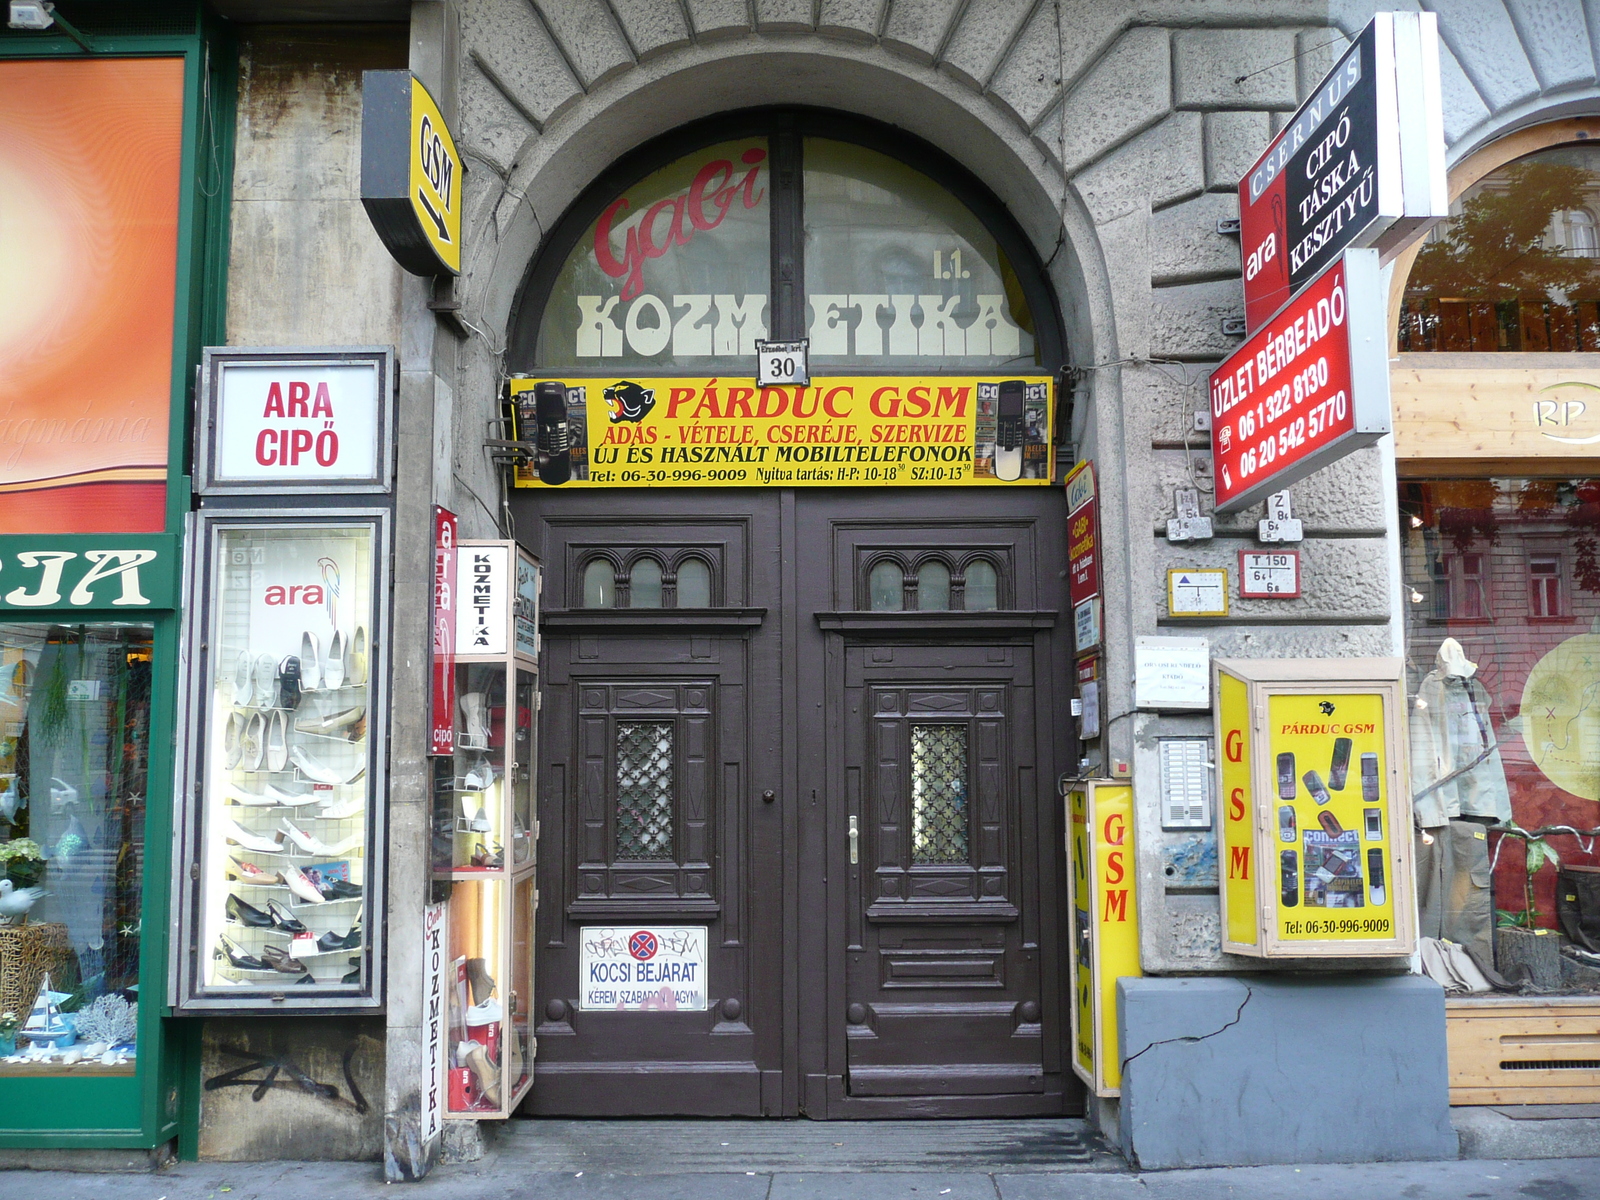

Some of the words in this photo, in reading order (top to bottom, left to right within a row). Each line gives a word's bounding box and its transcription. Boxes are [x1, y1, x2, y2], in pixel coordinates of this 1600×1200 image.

[1251, 55, 1358, 198] CSERNUS
[1306, 106, 1351, 180] CIPŐ
[420, 114, 454, 214] GSM
[1299, 149, 1361, 226] TÁSKA
[594, 147, 767, 302] Gabi
[1290, 165, 1375, 276] KESZTYŰ
[1246, 232, 1276, 282] ara
[770, 357, 796, 378] 30
[1213, 358, 1254, 418] ÜZLET
[1256, 273, 1345, 387] BÉRBEADÓ
[263, 381, 334, 419] ARA
[664, 378, 854, 419] PÁRDUC
[869, 386, 973, 419] GSM
[1238, 410, 1255, 442] 06
[1257, 402, 1265, 429] 1
[1266, 384, 1292, 423] 322
[1293, 357, 1328, 404] 8130
[1533, 400, 1586, 427] RP
[255, 420, 339, 467] CIPŐ
[593, 443, 620, 464] ÚJ
[626, 443, 654, 464] ÉS
[660, 442, 770, 463] HASZNÁLT
[775, 445, 973, 463] MOBILTELEFONOK
[601, 420, 658, 445] ADÁS
[678, 420, 760, 447] VÉTELE,
[766, 418, 864, 446] CSERÉJE,
[869, 424, 967, 443] SZERVIZE
[1240, 447, 1256, 478] 06
[1259, 435, 1276, 468] 20
[1278, 416, 1305, 456] 542
[1308, 390, 1346, 440] 5770
[590, 470, 617, 482] Tel:
[621, 469, 747, 482] 06-30-996-9009
[755, 467, 793, 484] Nyitva
[796, 466, 834, 481] tartás:
[837, 467, 860, 481] H-P:
[1274, 494, 1284, 507] Z
[0, 550, 158, 606] JA
[1252, 555, 1261, 566] T
[1266, 555, 1287, 566] 150
[264, 584, 324, 606] ara
[473, 554, 491, 646] KOZMETIKA
[1281, 721, 1340, 735] PÁRDUC
[1344, 723, 1375, 734] GSM
[1284, 920, 1303, 935] Tel:
[1305, 919, 1390, 934] 06-30-996-9009
[590, 962, 631, 982] KOCSI
[636, 958, 698, 982] BEJÁRAT
[588, 987, 617, 1004] KÉREM
[428, 928, 441, 1137] KOZMETIKA
